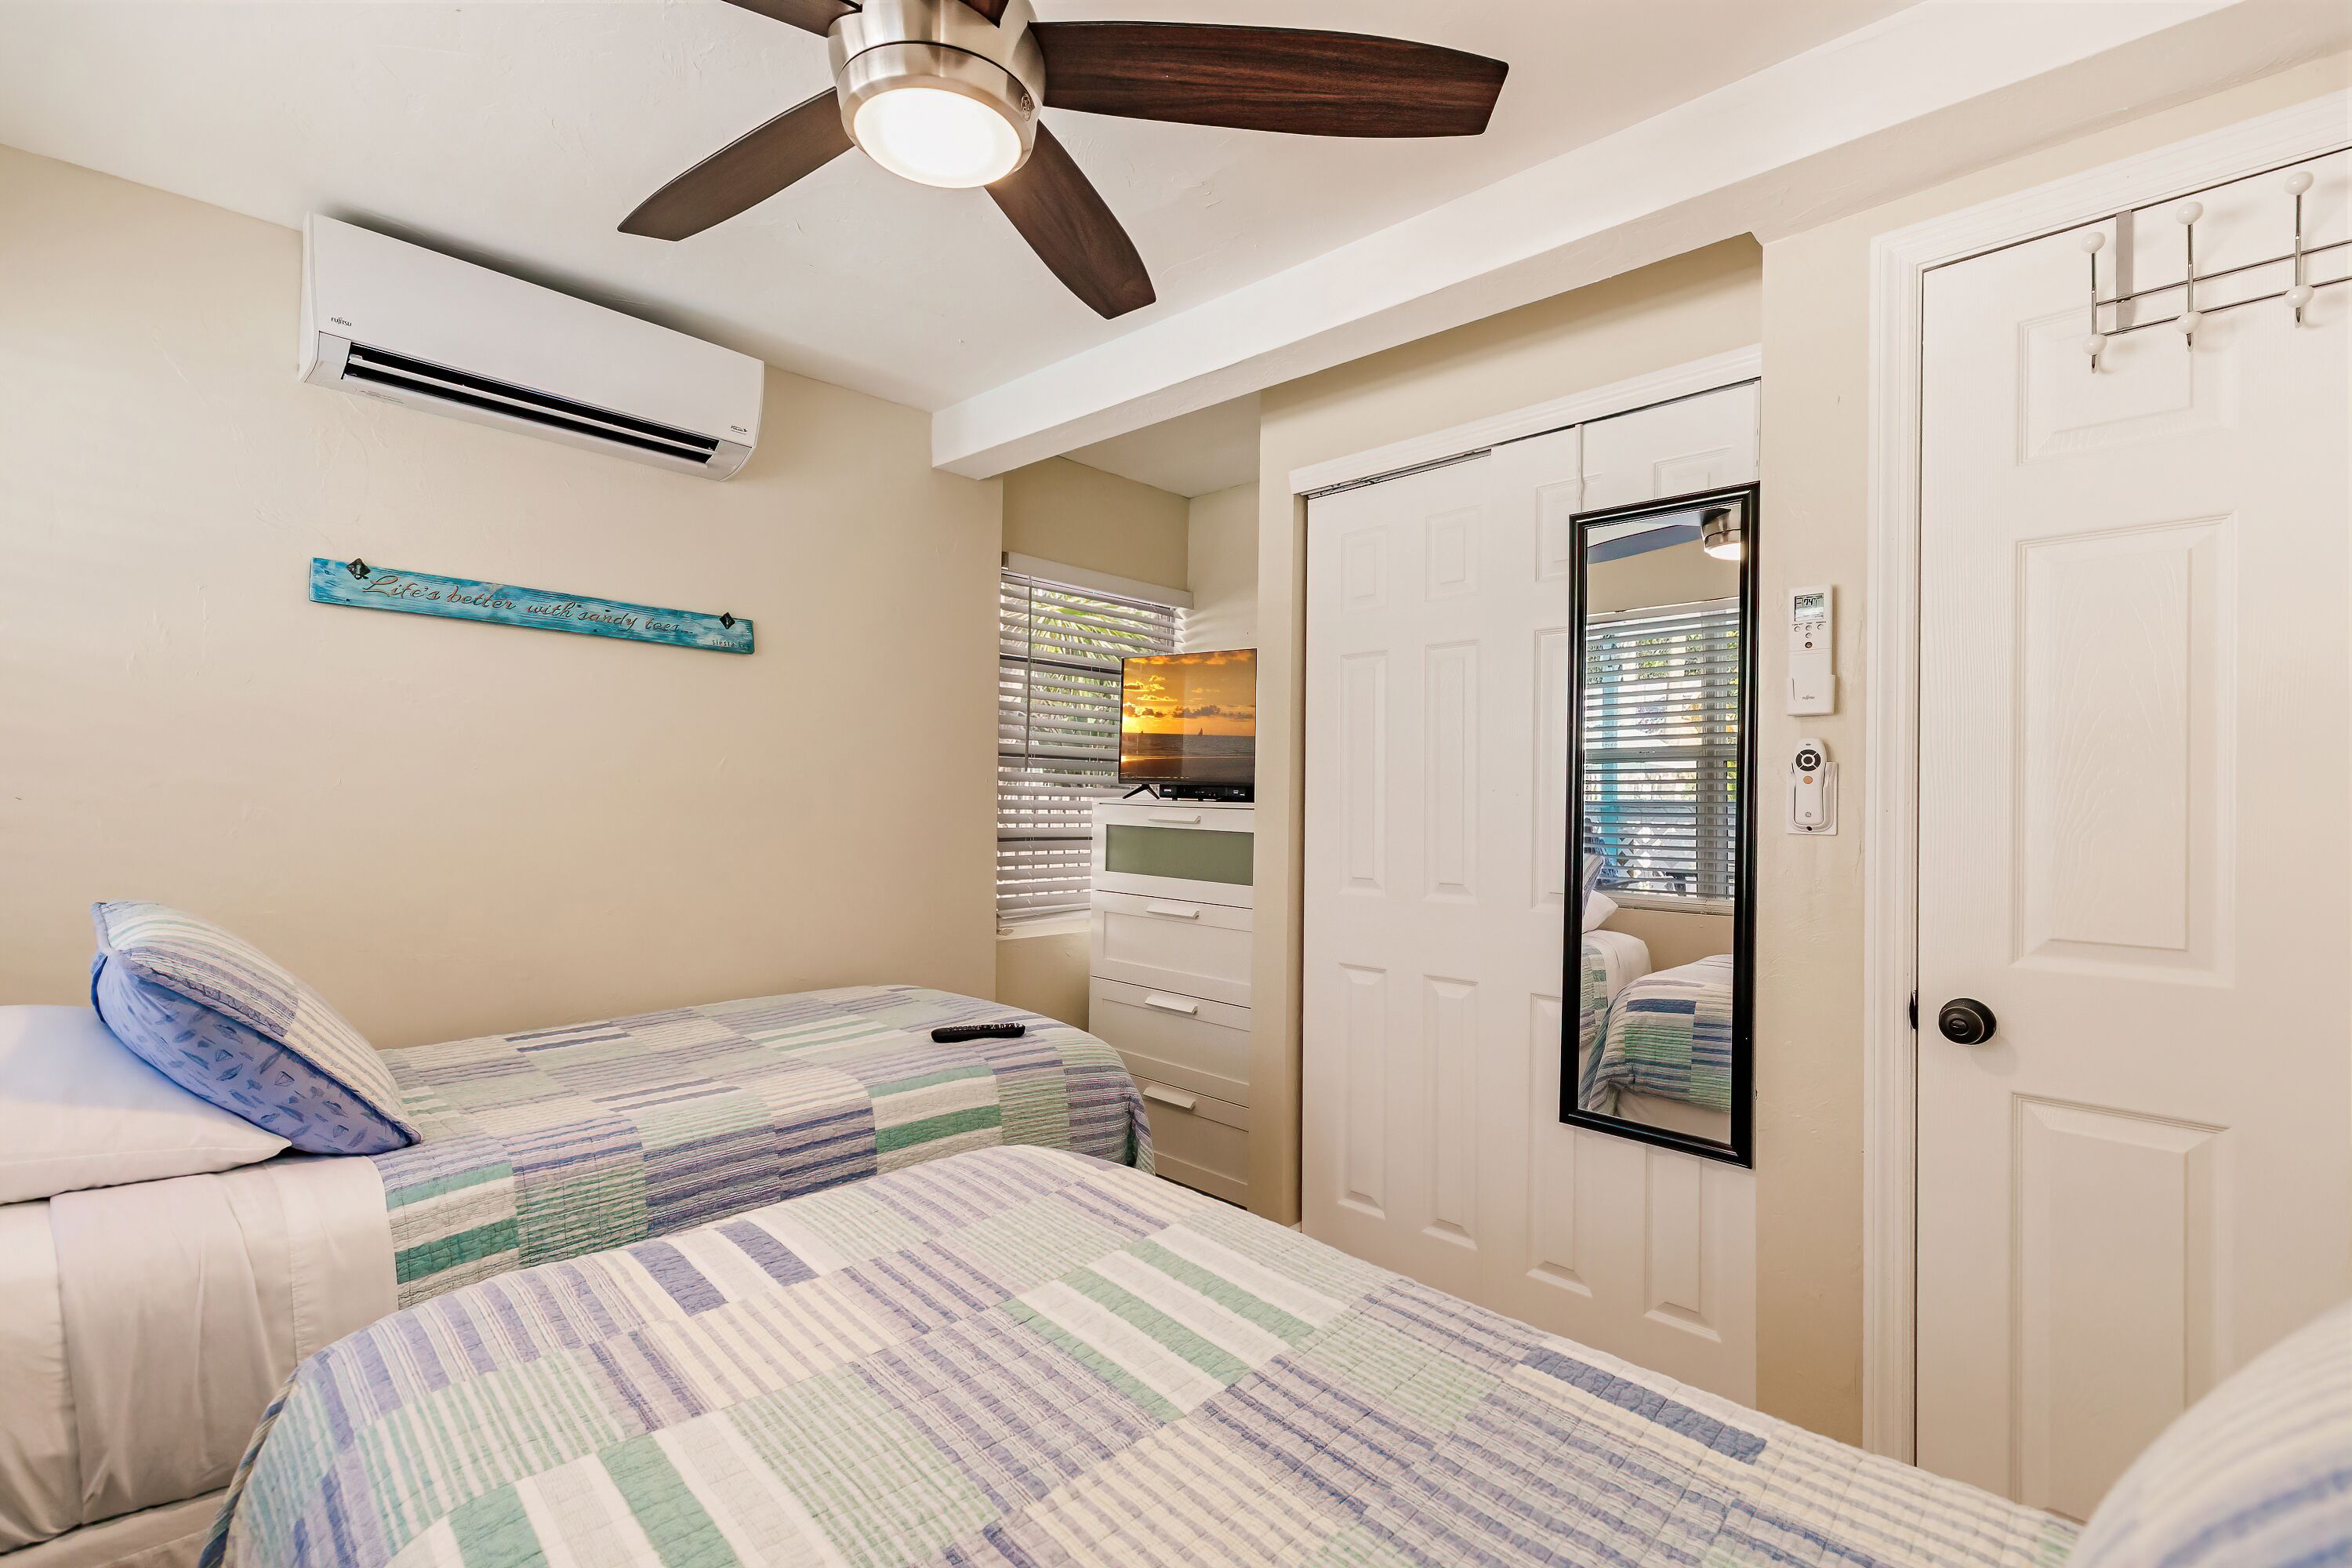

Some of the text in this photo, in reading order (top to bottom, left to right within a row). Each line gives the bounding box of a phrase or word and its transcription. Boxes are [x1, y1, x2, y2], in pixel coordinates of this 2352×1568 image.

[362, 575, 441, 601] Life's
[446, 586, 517, 610] better
[526, 601, 576, 619] with
[578, 612, 638, 632] sandy
